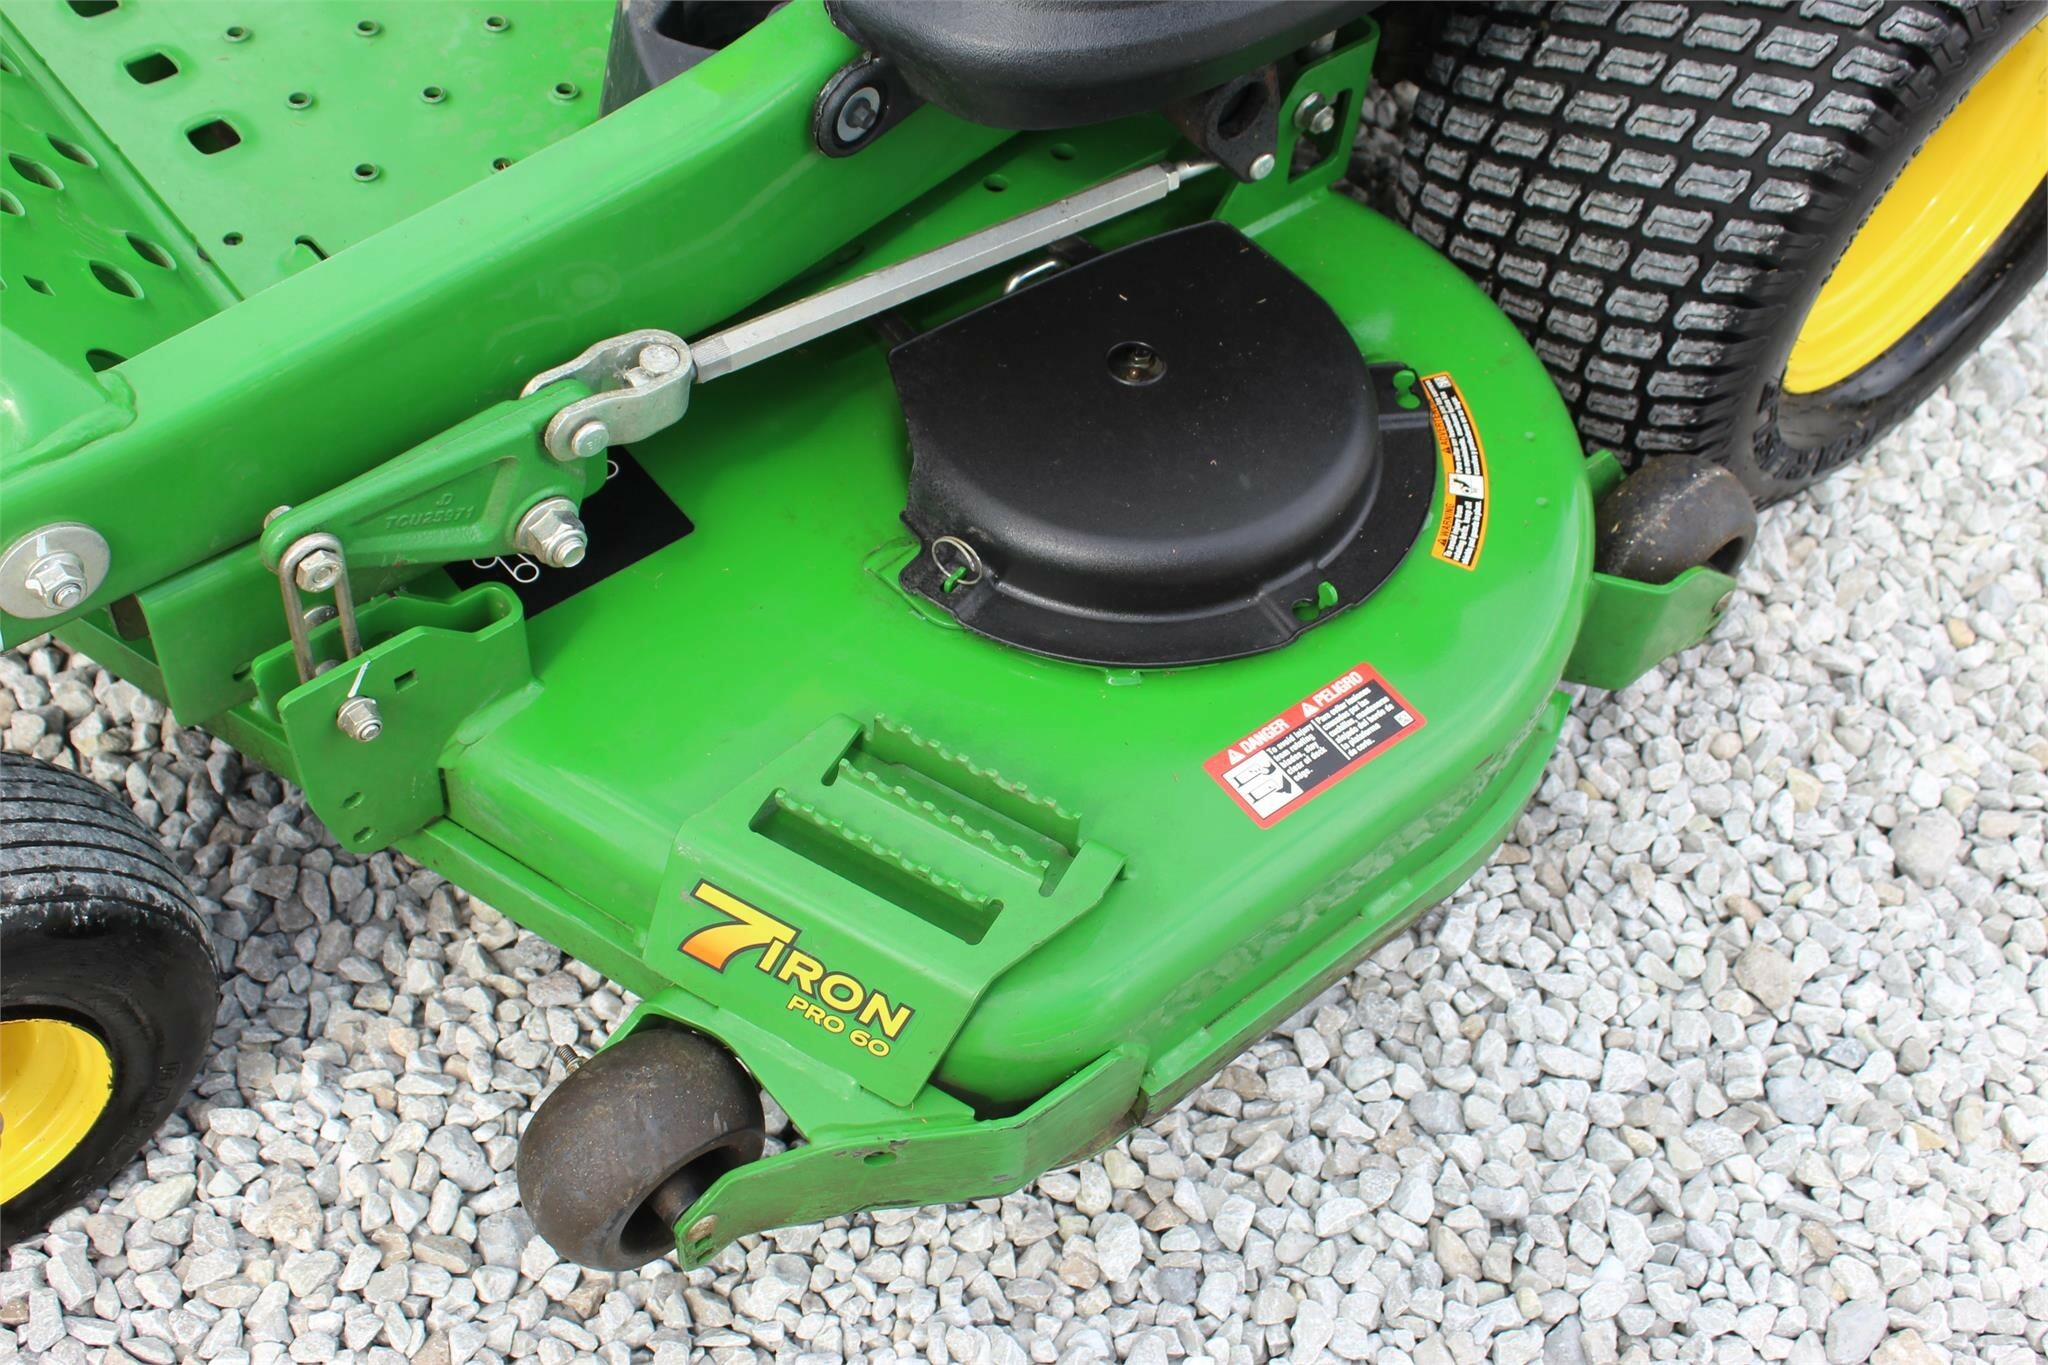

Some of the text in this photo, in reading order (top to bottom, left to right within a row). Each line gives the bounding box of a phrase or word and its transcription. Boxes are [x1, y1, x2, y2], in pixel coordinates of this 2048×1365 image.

[1440, 503, 1454, 538] WARNING
[1311, 671, 1363, 708] PELIGRO
[1239, 717, 1290, 753] DANGER
[677, 878, 916, 1042] 7 IRON
[787, 994, 892, 1058] PRO 60
